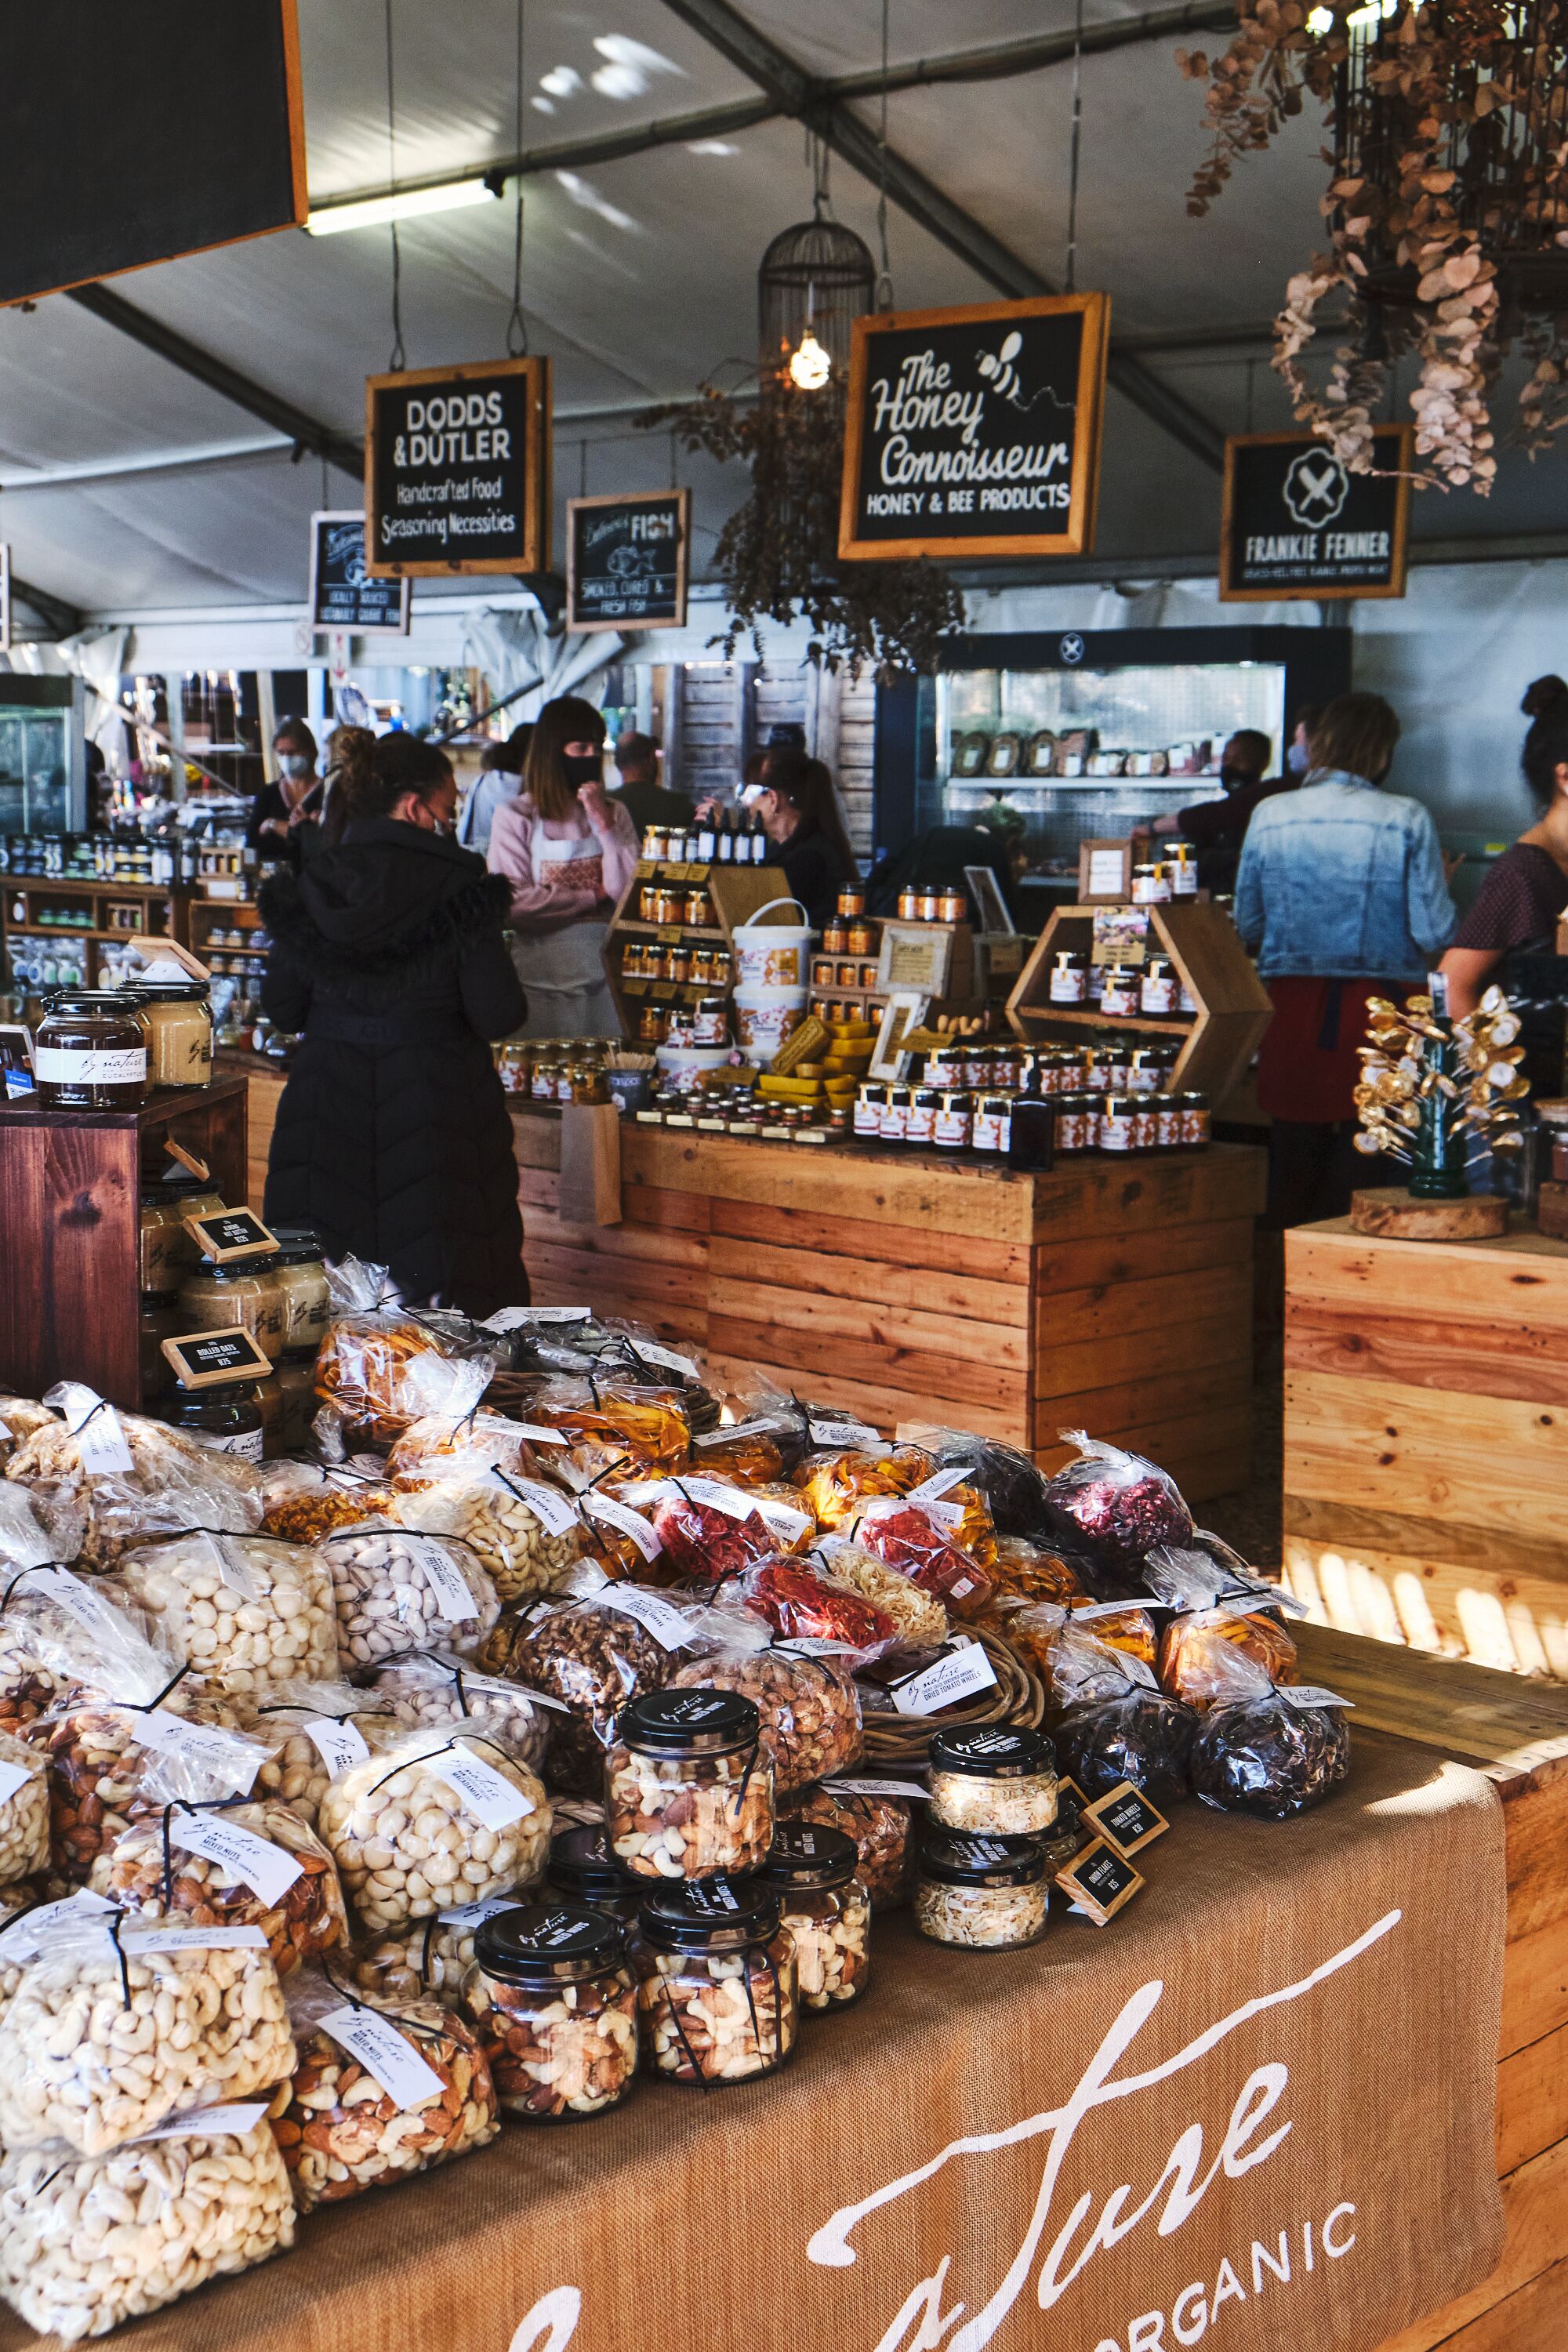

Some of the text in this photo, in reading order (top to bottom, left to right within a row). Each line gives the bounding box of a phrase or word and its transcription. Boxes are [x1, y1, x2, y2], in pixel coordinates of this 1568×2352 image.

[902, 350, 951, 394] The
[407, 391, 503, 431] DODDS
[871, 378, 984, 445] Honey
[880, 434, 1069, 486] Connoisseur
[397, 476, 503, 506] Handcrafted Food
[867, 483, 1072, 516] HONEY & BEE PRODUCTS
[381, 513, 448, 546] Seasoning
[449, 508, 517, 535] Necessities
[1246, 531, 1390, 563] FRANKIE FENNER
[197, 1346, 221, 1356] ROLLED
[220, 1344, 237, 1352] OATS
[217, 1357, 232, 1366] R75
[699, 1491, 720, 1502] TOMATO
[720, 1501, 740, 1511] WHEELS
[774, 1521, 793, 1533] STRIPS
[908, 1658, 964, 1707] by nature
[924, 1671, 982, 1701] DRIED TOMATO WHEELS
[943, 1675, 960, 1686] CERTIFIED
[960, 1668, 975, 1679] ORGANIC
[660, 1694, 706, 1723] by nature
[955, 1743, 971, 1755] by
[969, 1728, 1000, 1746] nature
[452, 1772, 483, 1801] MACADAMIAS
[1110, 1812, 1129, 1828] TOMATO
[1123, 1802, 1142, 1818] WHEELS
[1131, 1823, 1144, 1835] R30
[202, 1838, 241, 1860] MIXED NUTS
[1088, 1869, 1102, 1884] ONION
[1098, 1860, 1114, 1875] FLAKES
[1108, 1878, 1120, 1891] R35
[518, 1911, 568, 1948] by nature
[546, 1922, 590, 1946] MIXED NUTS
[352, 2032, 383, 2060] MIXED NUTS
[806, 1908, 1403, 2352] ature
[1094, 2202, 1357, 2352] RGANIC
